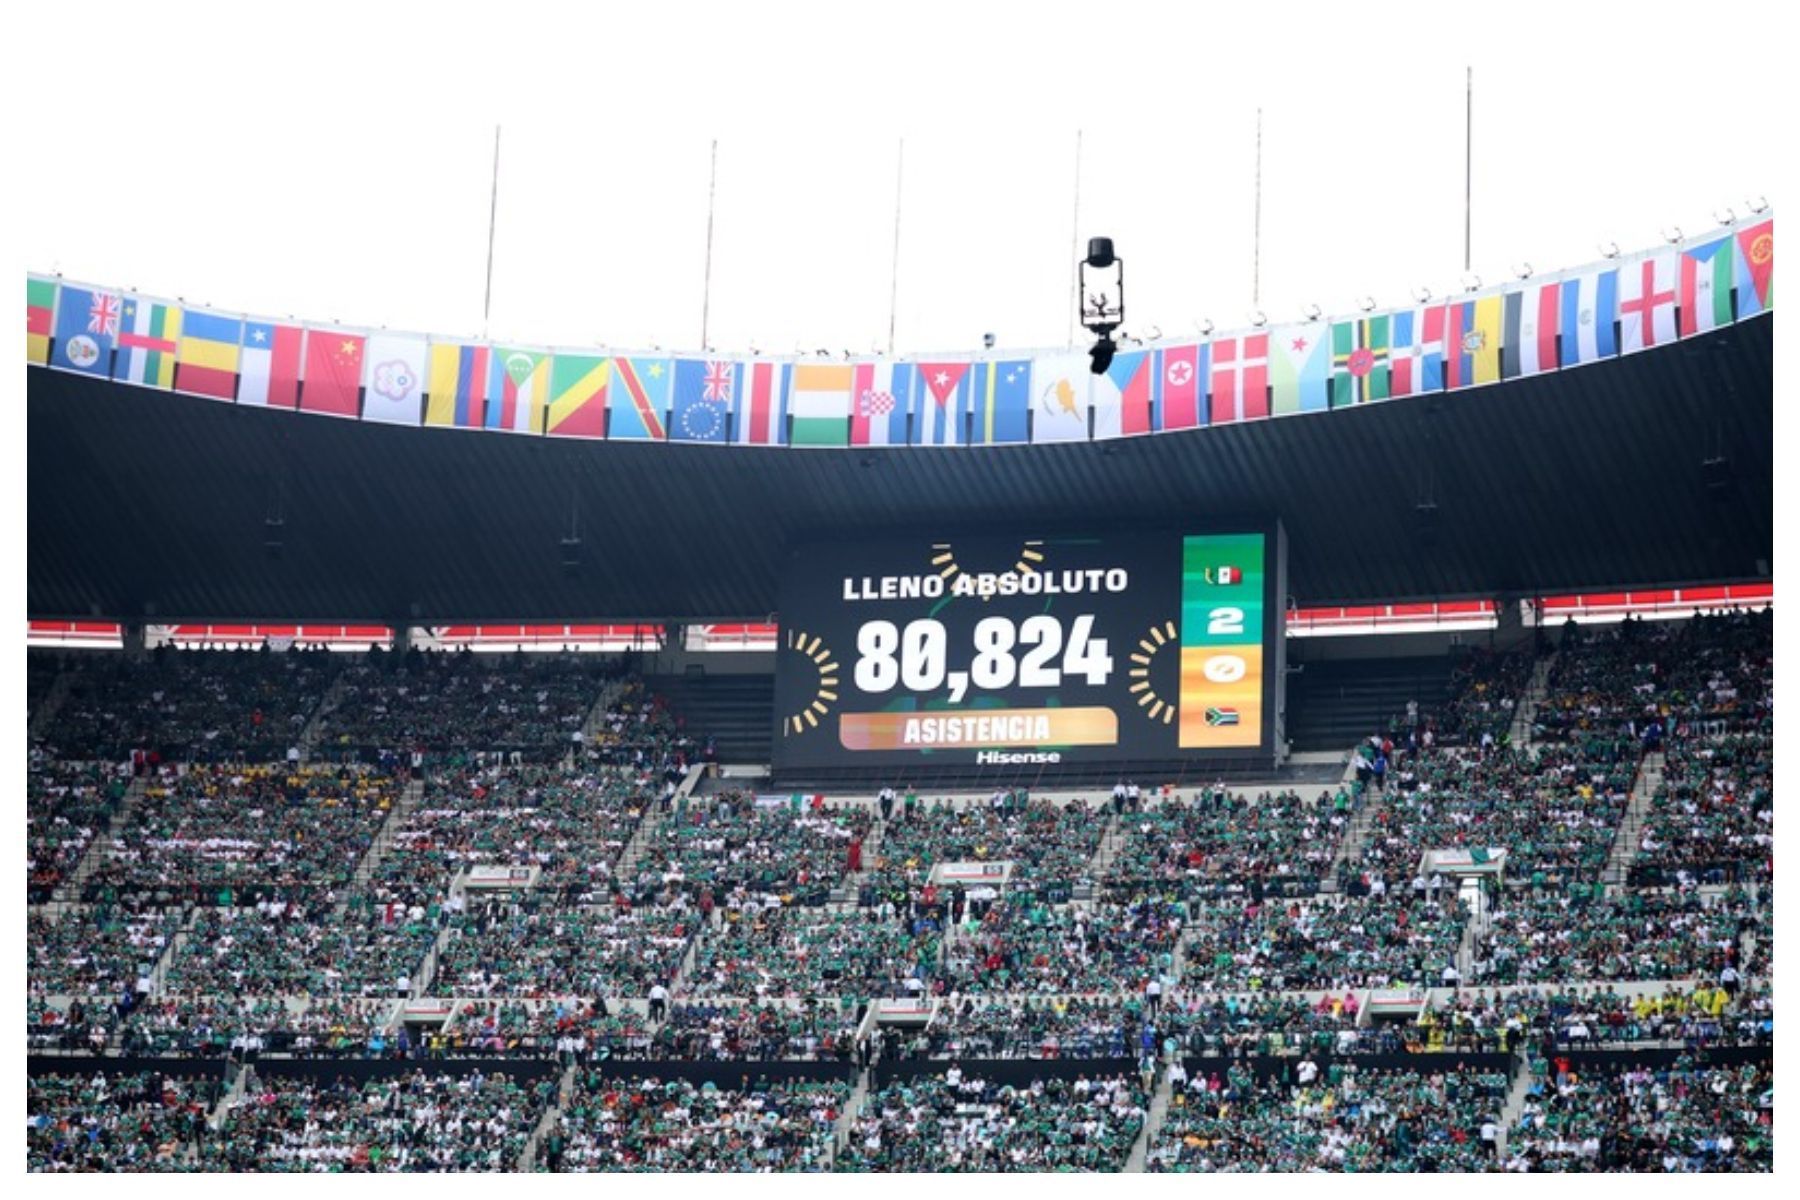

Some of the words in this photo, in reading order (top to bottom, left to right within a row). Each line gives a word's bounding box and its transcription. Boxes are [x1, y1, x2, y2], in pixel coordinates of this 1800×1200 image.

[843, 574, 945, 600] LLENO
[953, 568, 1128, 597] ABSOLUTO
[1207, 606, 1245, 636] 2
[854, 614, 1113, 703] 80,824
[1203, 655, 1246, 683] 0
[904, 715, 1051, 744] ASISTENCIA
[976, 751, 1062, 765] Hisense
